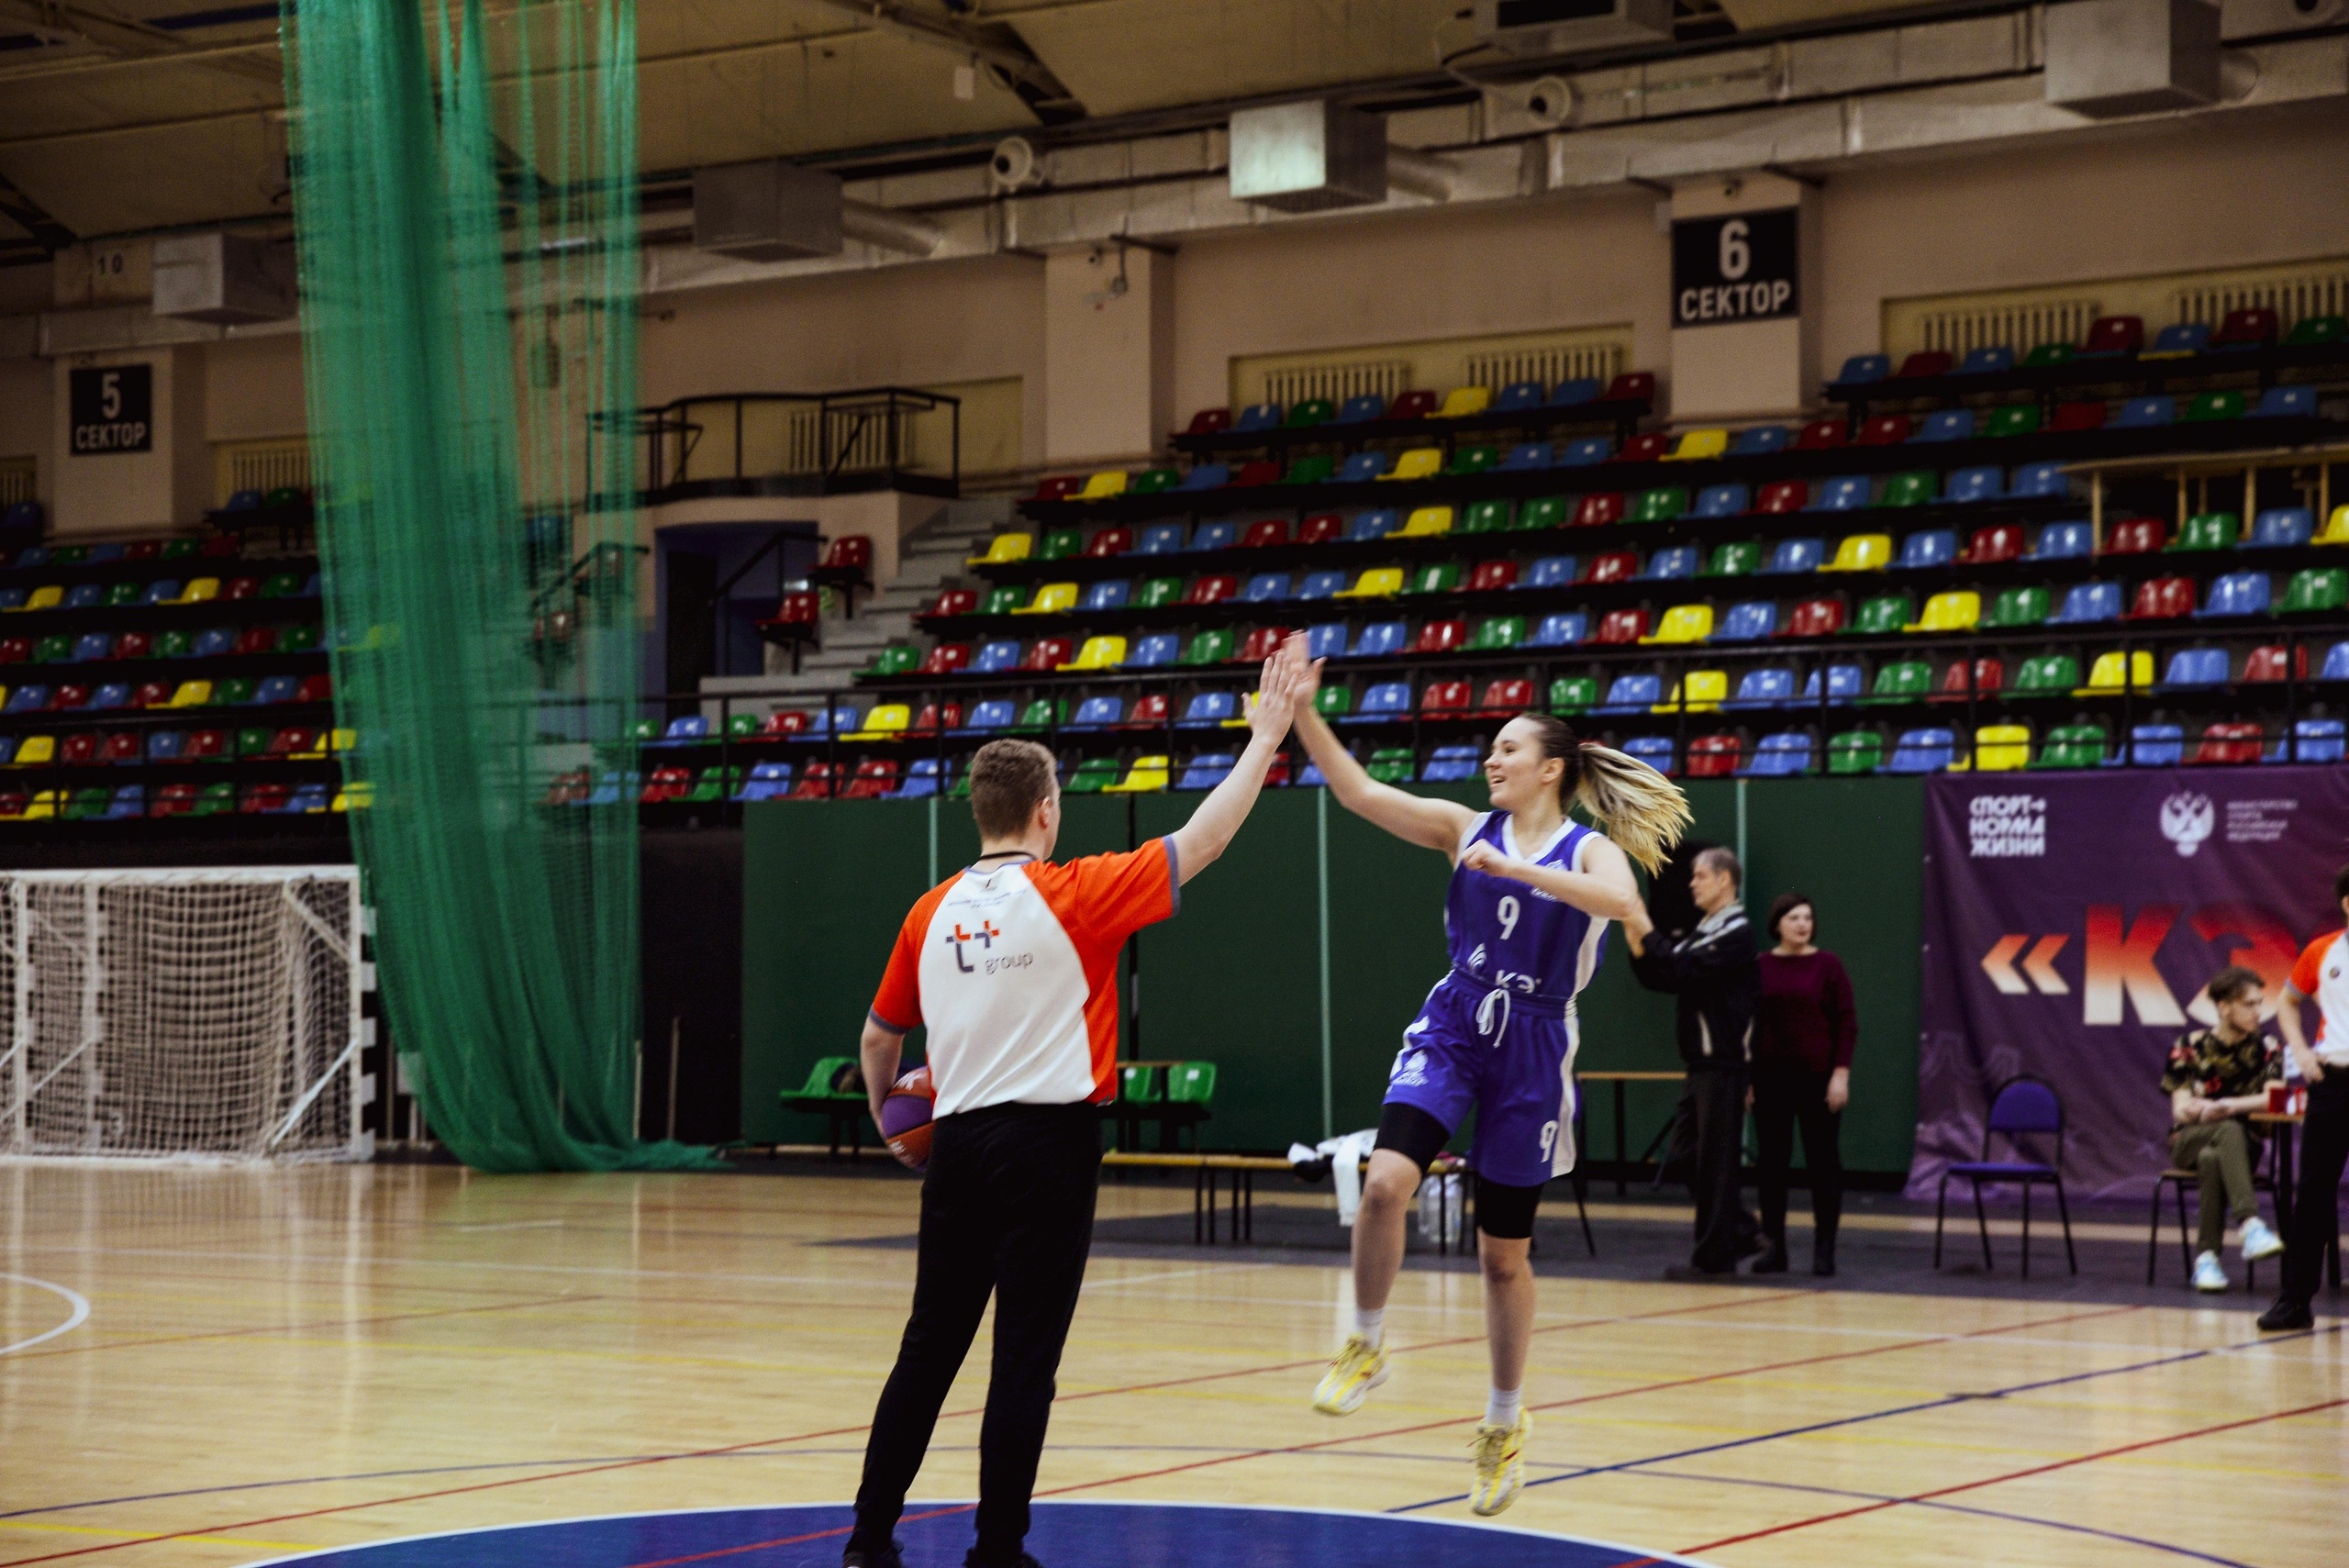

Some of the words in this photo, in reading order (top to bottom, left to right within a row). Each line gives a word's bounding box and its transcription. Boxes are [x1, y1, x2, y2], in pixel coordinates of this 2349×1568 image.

[1720, 219, 1751, 281] 6
[1680, 280, 1791, 320] СЕКТОР
[102, 372, 121, 419] 5
[75, 422, 146, 450] СЕКТОР
[1969, 815, 2045, 836] НОРМА
[1970, 836, 2045, 857] ЖИЗНИ
[1497, 895, 1520, 940] 9
[985, 952, 1033, 975] group
[1540, 1120, 1559, 1163] 9
